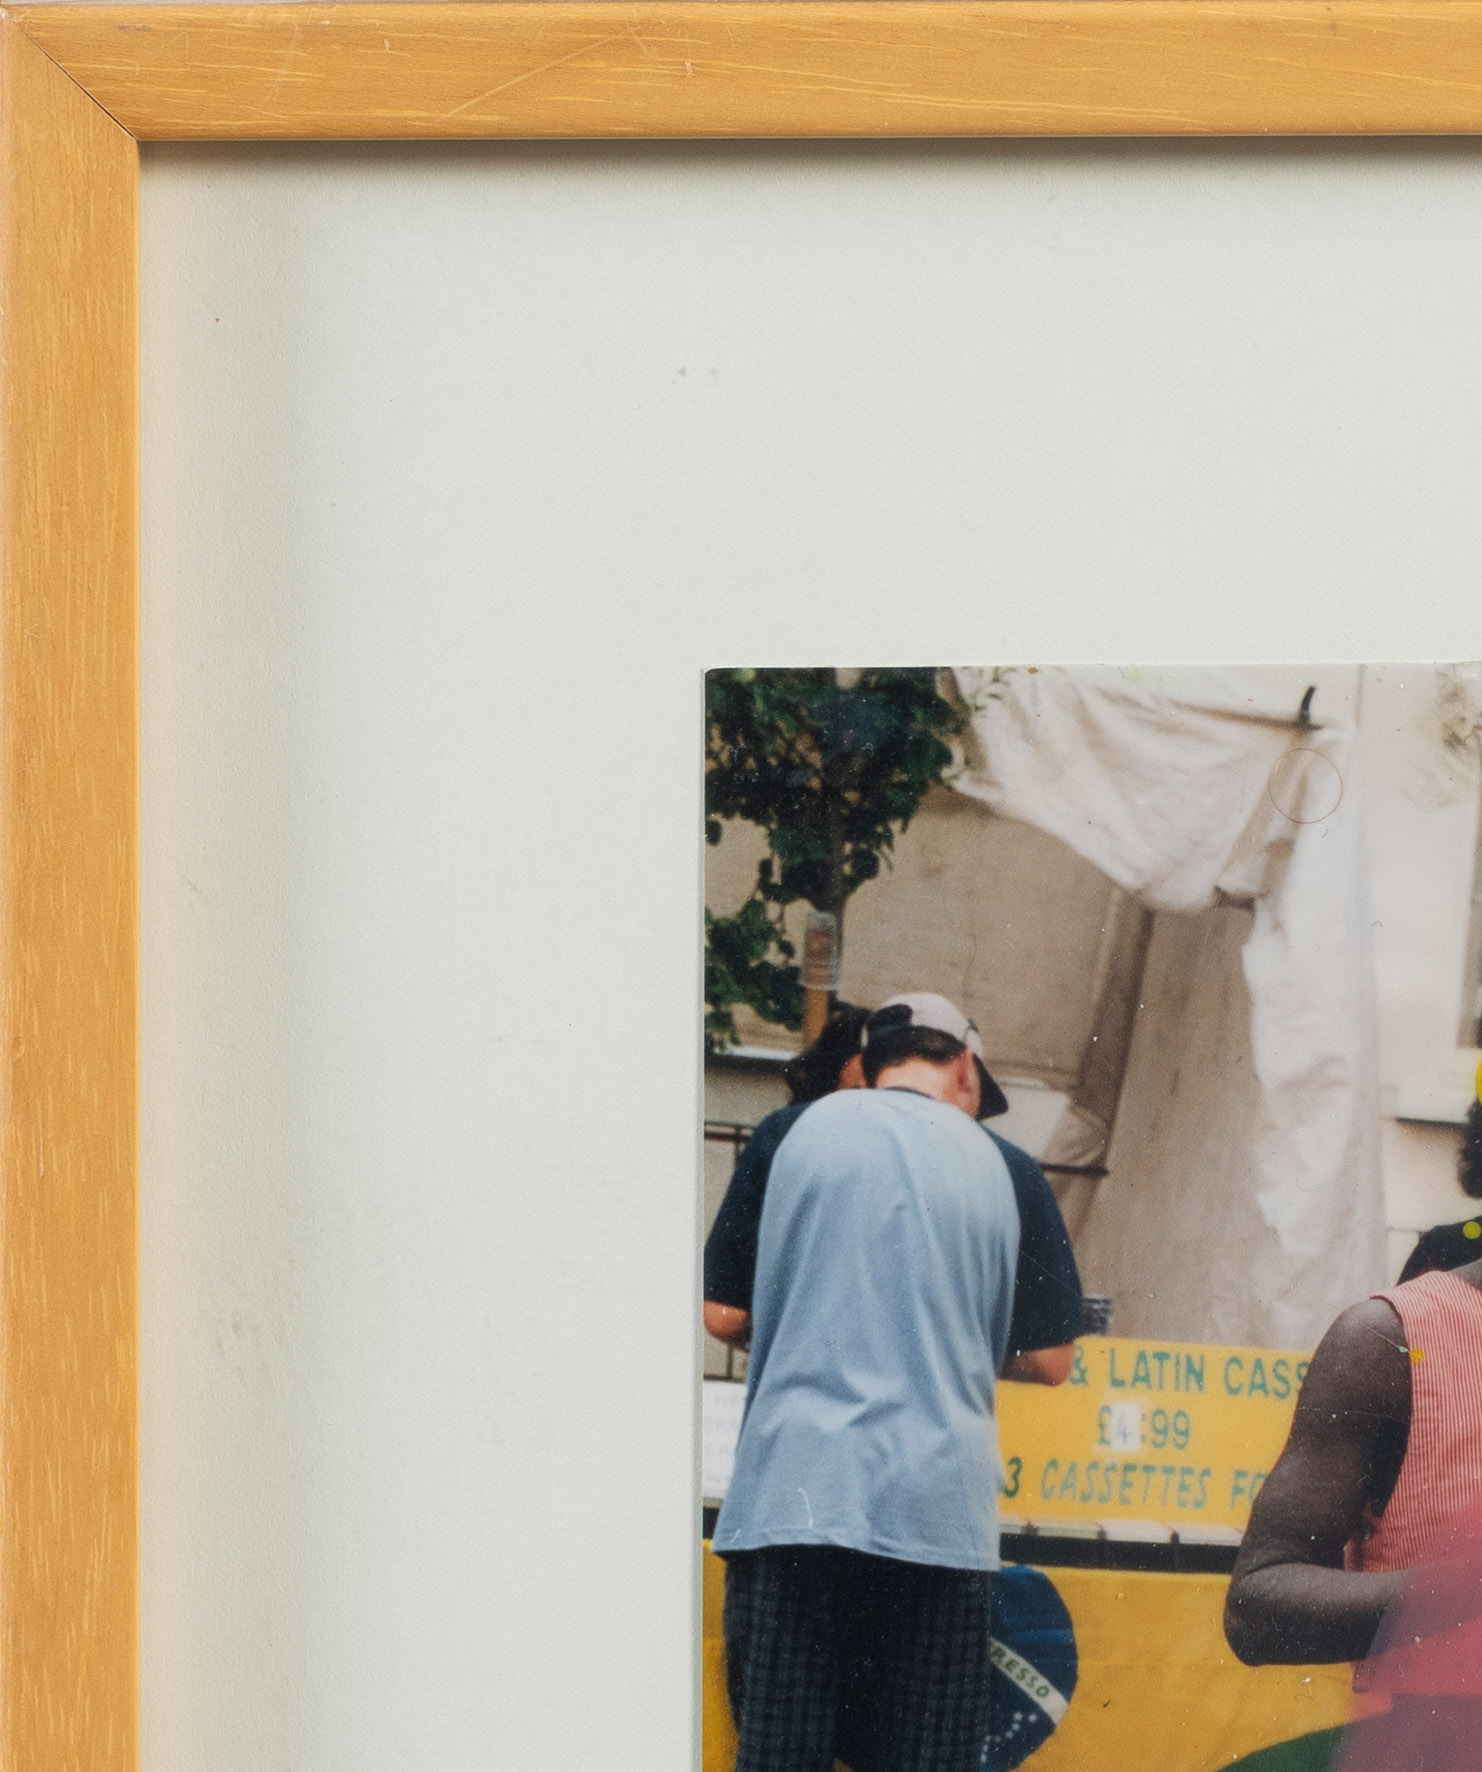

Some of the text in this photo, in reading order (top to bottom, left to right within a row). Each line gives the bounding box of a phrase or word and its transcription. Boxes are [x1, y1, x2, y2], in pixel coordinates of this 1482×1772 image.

[1070, 1346, 1088, 1386] &
[1109, 1348, 1206, 1394] LATIN
[1003, 1456, 1022, 1499] 3
[1040, 1458, 1212, 1510] CASSETTES
